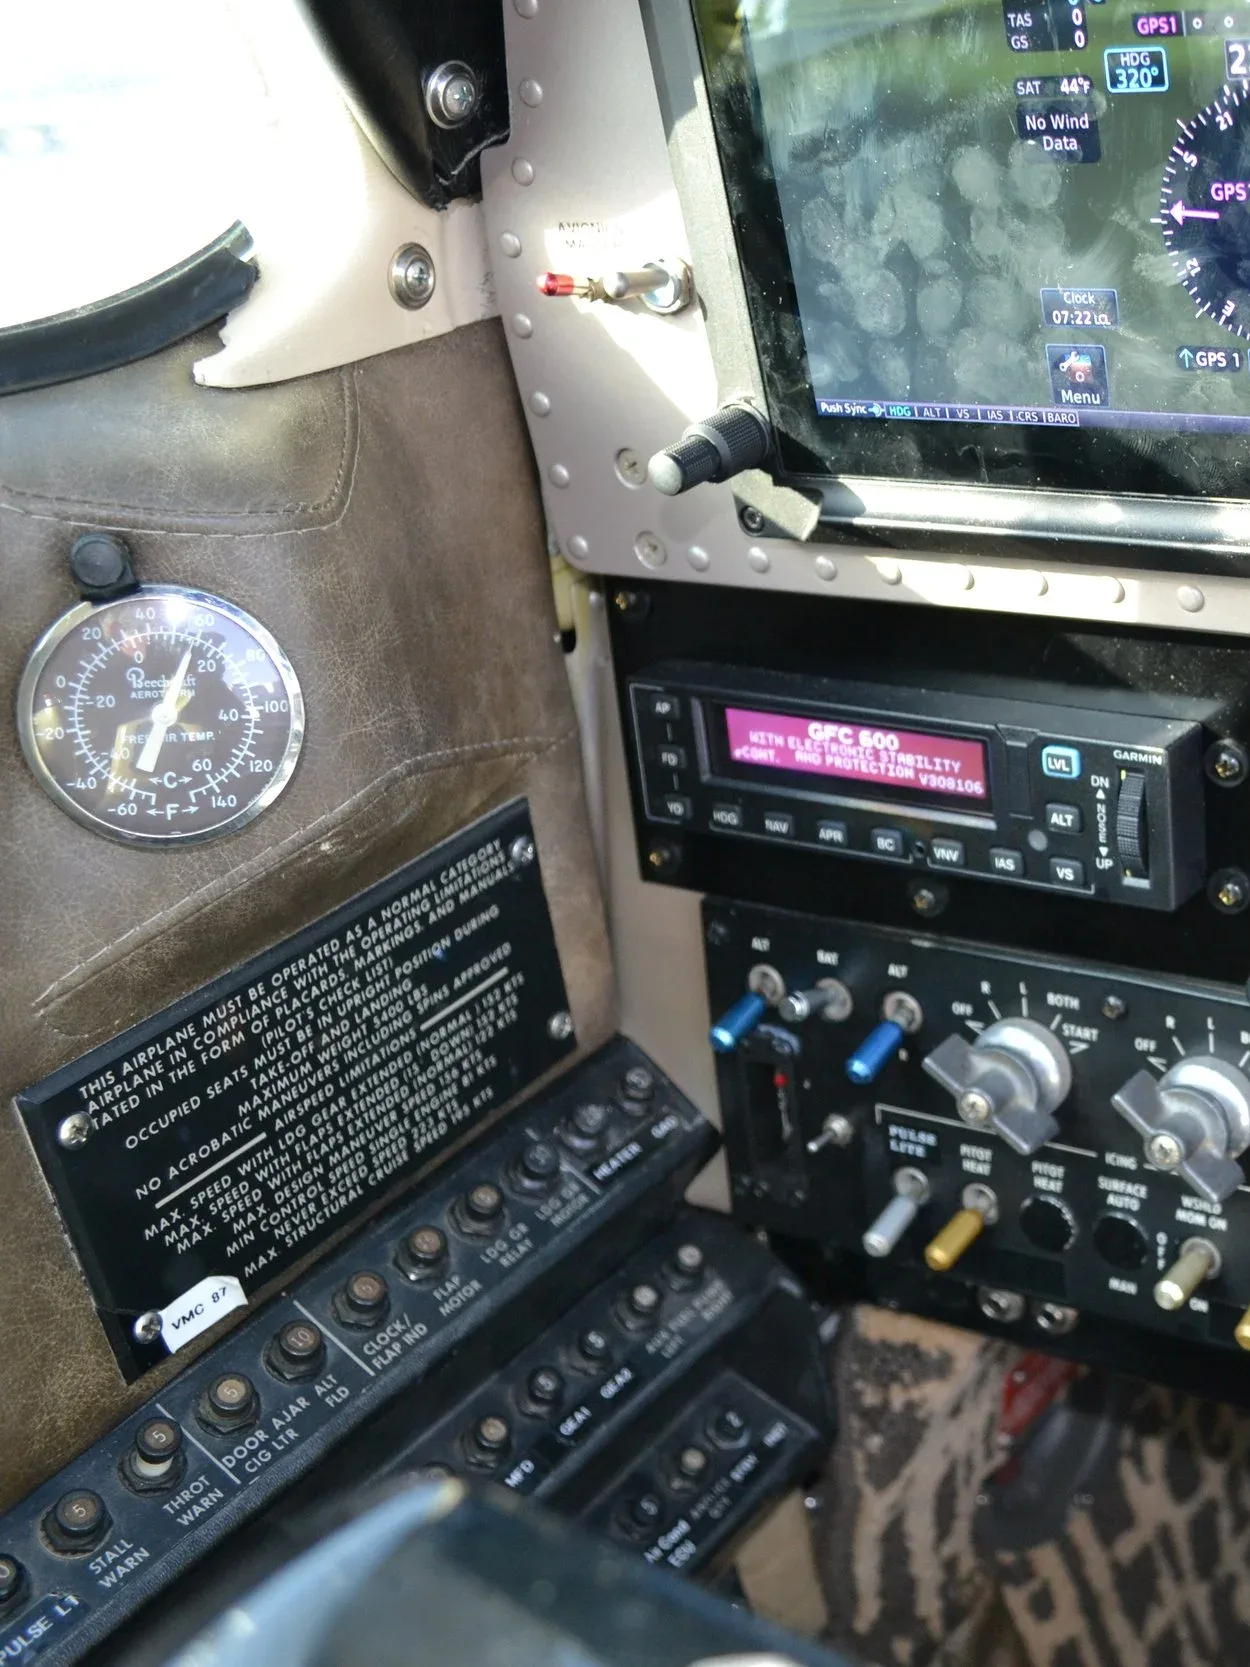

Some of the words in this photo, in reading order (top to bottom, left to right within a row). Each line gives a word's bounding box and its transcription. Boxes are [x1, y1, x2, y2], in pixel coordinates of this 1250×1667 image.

[1007, 13, 1033, 28] TAS
[1137, 17, 1177, 35] GPS1
[1120, 52, 1150, 67] HDG
[1115, 67, 1159, 89] 320°
[1017, 81, 1041, 95] SAT
[1025, 115, 1046, 131] No
[1051, 113, 1089, 130] Wind
[1043, 136, 1078, 151] Data
[1063, 292, 1096, 304] Clock
[1061, 389, 1101, 405] Menu
[135, 608, 156, 620] 40
[82, 628, 102, 641] 20
[218, 708, 239, 722] 40
[808, 722, 854, 746] GFC
[858, 730, 900, 751] 600
[750, 731, 785, 748] WITH
[787, 736, 875, 761] ELECTRONIC
[880, 750, 962, 772] STABILITY
[1113, 750, 1163, 766] GARMIN
[191, 758, 213, 772] 60
[250, 759, 273, 773] 120
[826, 755, 915, 780] PROTECTION
[1048, 757, 1070, 773] LVL
[66, 777, 97, 791] -40
[1091, 774, 1109, 789] DN
[107, 803, 138, 817] -60
[211, 794, 237, 808] 140
[1051, 812, 1075, 827] ALT
[934, 848, 960, 863] VNV
[994, 857, 1015, 872] IAS
[1056, 867, 1075, 882] VS
[80, 1071, 115, 1098] THIS
[123, 1023, 196, 1075] AIRPLANE
[203, 996, 241, 1028] MUST
[249, 983, 265, 1001] BE
[272, 939, 339, 986] OPERATED
[347, 925, 362, 943] AS
[368, 917, 376, 930] A
[381, 881, 436, 921] NORMAL
[441, 840, 502, 884] CATEGORY
[89, 1061, 164, 1114] AIRPLANE
[170, 1047, 186, 1064] IN
[194, 987, 287, 1050] COMPLIANCE
[294, 963, 328, 990] WITH
[333, 945, 355, 966] THE
[361, 899, 430, 949] OPERATING
[434, 851, 504, 904] LIMITATIONS
[262, 1007, 314, 1048] (PILOT'S
[319, 978, 360, 1010] CHECK
[126, 1096, 200, 1148] OCCUPIED
[207, 1066, 247, 1098] SEATS
[255, 1038, 290, 1069] MUST
[297, 1025, 312, 1042] BE
[318, 1013, 332, 1029] IN
[337, 975, 389, 1016] UPRIGHT
[395, 937, 450, 979] POSITION
[454, 905, 499, 941] DURING
[251, 1042, 314, 1089] TAKE-OFF
[322, 1020, 349, 1045] AND
[355, 979, 412, 1023] LANDING
[239, 1062, 312, 1116] MAXIMUM
[317, 1024, 366, 1063] WEIGHT
[373, 1000, 404, 1028] 5400
[136, 1177, 161, 1199] NO
[170, 1117, 251, 1179] ACROBATIC
[258, 1060, 339, 1120] MANEUVERS
[344, 1010, 412, 1063] INCLUDING
[417, 985, 449, 1014] SPINS
[454, 943, 511, 989] APPROVED
[276, 1084, 333, 1131] AIRSPEED
[339, 1028, 416, 1087] LIMITATIONS
[1098, 1175, 1148, 1200] SURFACE
[1106, 1192, 1141, 1212] AUTO
[172, 1304, 205, 1331] VMC
[211, 1286, 229, 1304] 87
[362, 1312, 412, 1356] CLOCK/
[221, 1428, 270, 1469] DOOR
[271, 1396, 311, 1430] AJAR
[245, 1449, 272, 1474] CIG
[272, 1427, 300, 1452] LTR
[161, 1475, 212, 1515] THROT
[176, 1488, 225, 1527] WARN
[88, 1538, 134, 1575] STALL
[99, 1547, 151, 1589] WARN
[55, 1594, 80, 1618] LT
